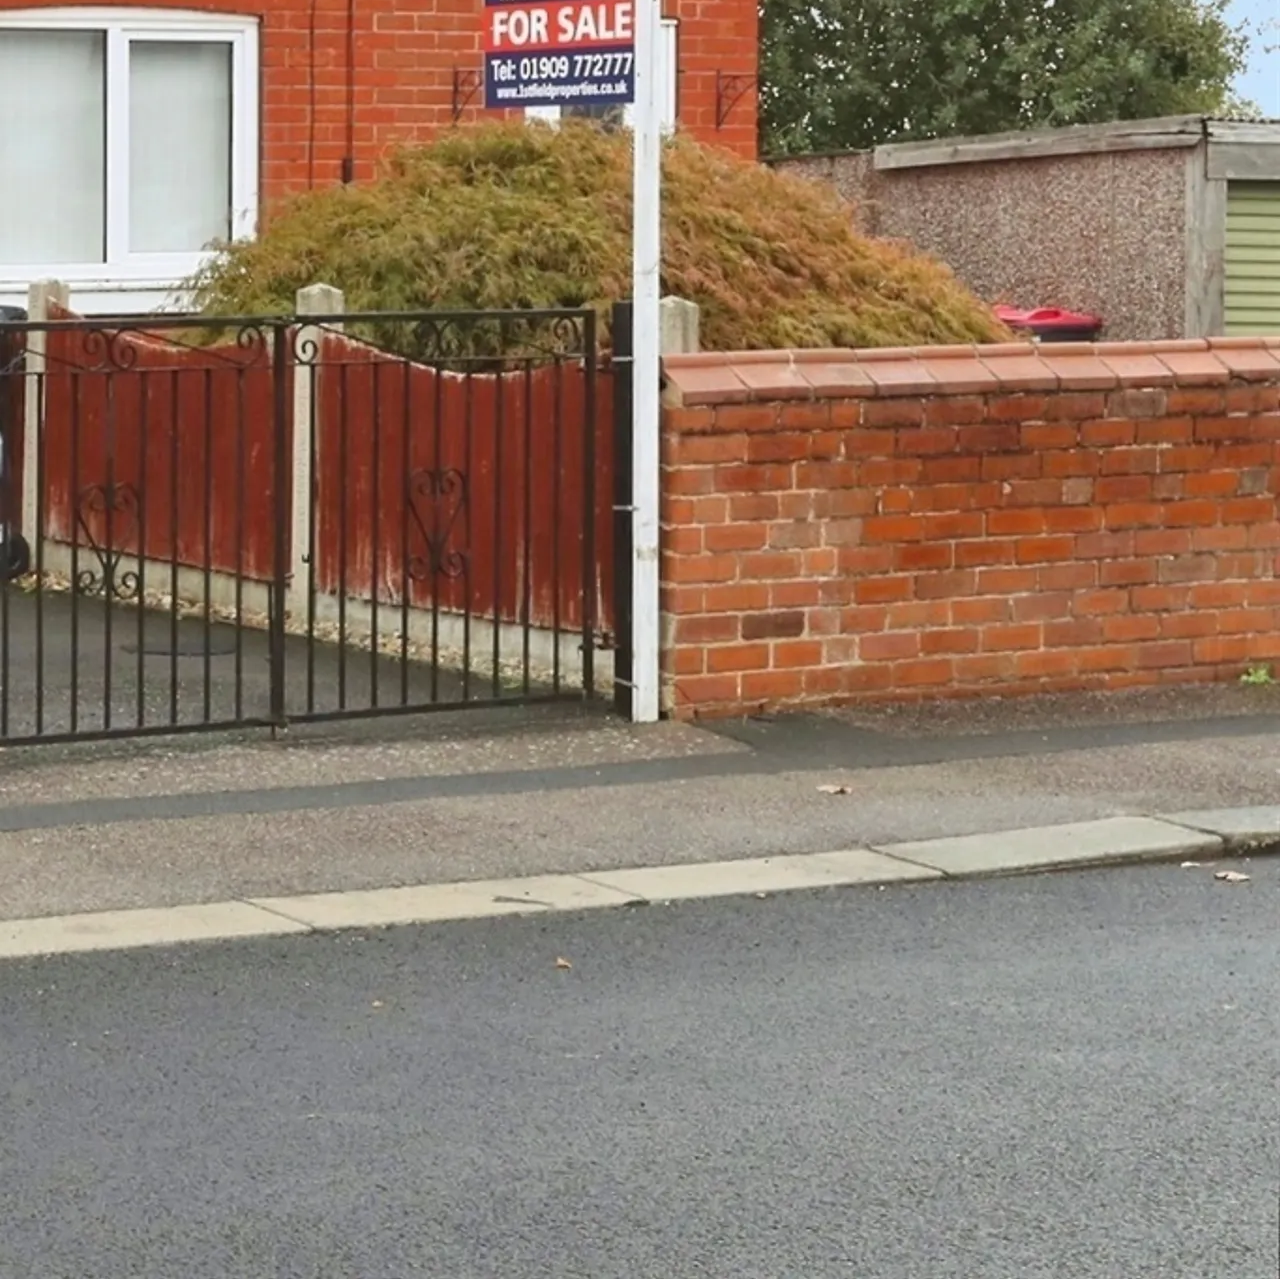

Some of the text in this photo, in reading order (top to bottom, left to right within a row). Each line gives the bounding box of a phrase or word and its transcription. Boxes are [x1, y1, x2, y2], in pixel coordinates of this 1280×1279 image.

[493, 2, 632, 46] FOR SALE
[491, 53, 633, 81] Tel: 01909 772777
